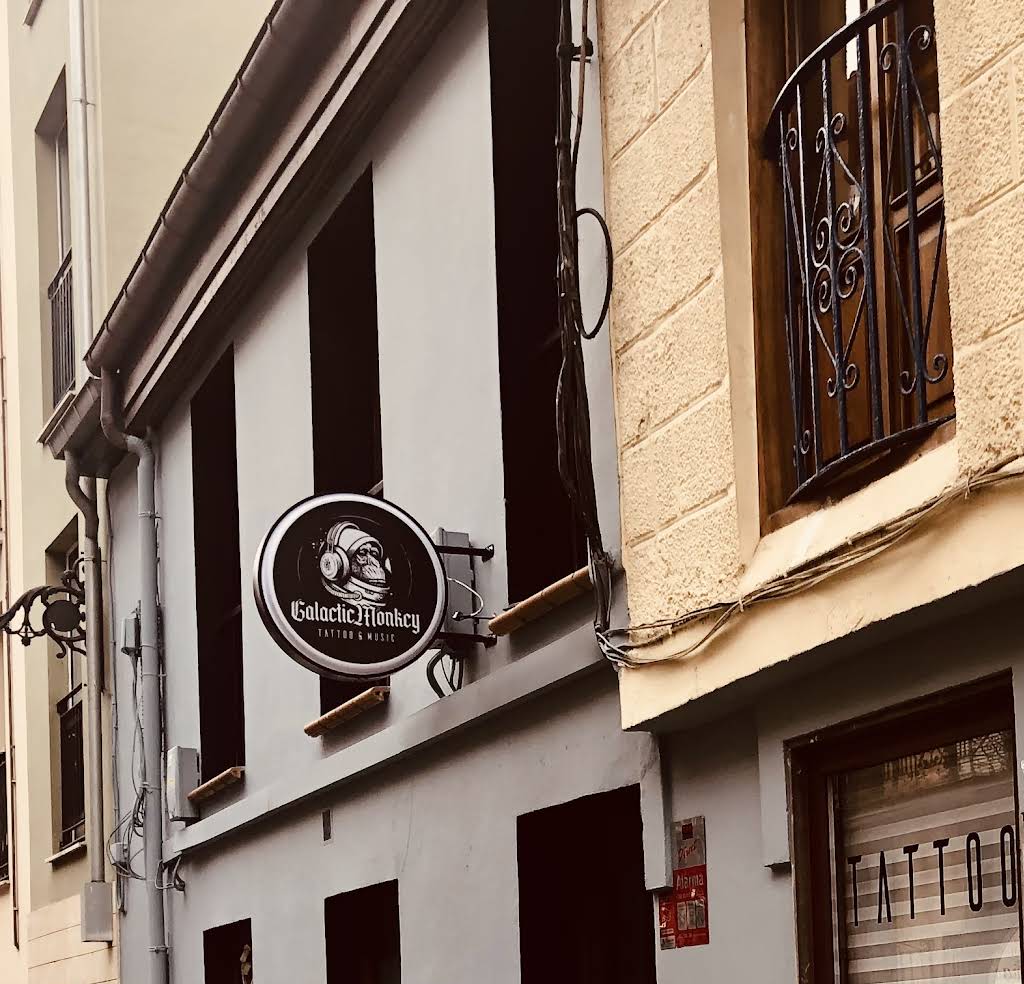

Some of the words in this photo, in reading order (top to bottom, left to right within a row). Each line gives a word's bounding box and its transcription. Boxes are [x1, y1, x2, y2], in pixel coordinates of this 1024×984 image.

[291, 599, 355, 624] Galactic
[354, 604, 420, 635] Monkey
[318, 628, 354, 640] TATTOO
[367, 632, 395, 643] MUSIC
[676, 873, 704, 890] Alarma
[848, 825, 1017, 927] TATTOO
